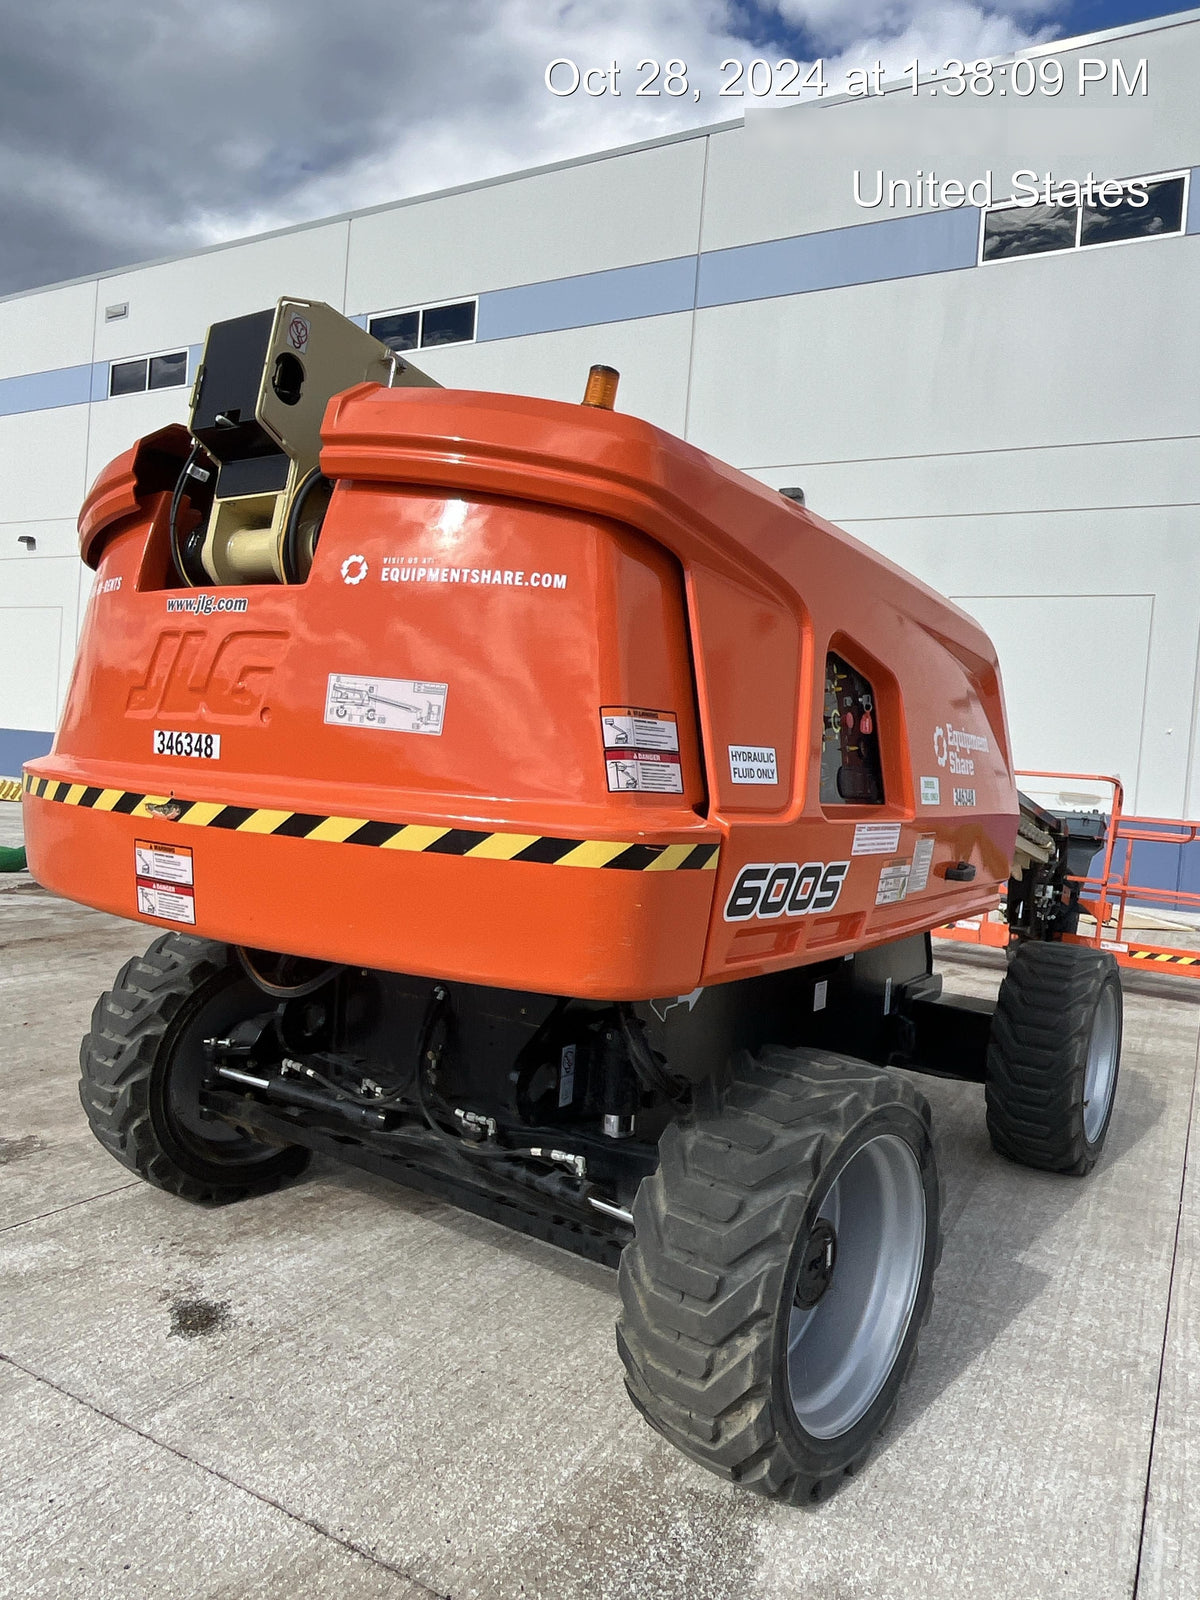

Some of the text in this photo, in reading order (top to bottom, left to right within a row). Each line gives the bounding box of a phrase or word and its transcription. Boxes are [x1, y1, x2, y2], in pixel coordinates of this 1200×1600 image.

[383, 556, 405, 565] VISIT
[407, 556, 418, 565] US
[380, 567, 568, 589] EQUIPMENTSHARE.COM
[166, 594, 249, 615] www.jlg.com
[125, 629, 291, 726] JLG
[157, 731, 213, 758] 346348
[946, 723, 990, 754] Equipment
[638, 752, 661, 761] DANGER
[731, 750, 775, 763] HYDRAULIC
[949, 751, 975, 776] Share
[732, 767, 775, 779] FLUID ONLY
[723, 860, 851, 922] 600S
